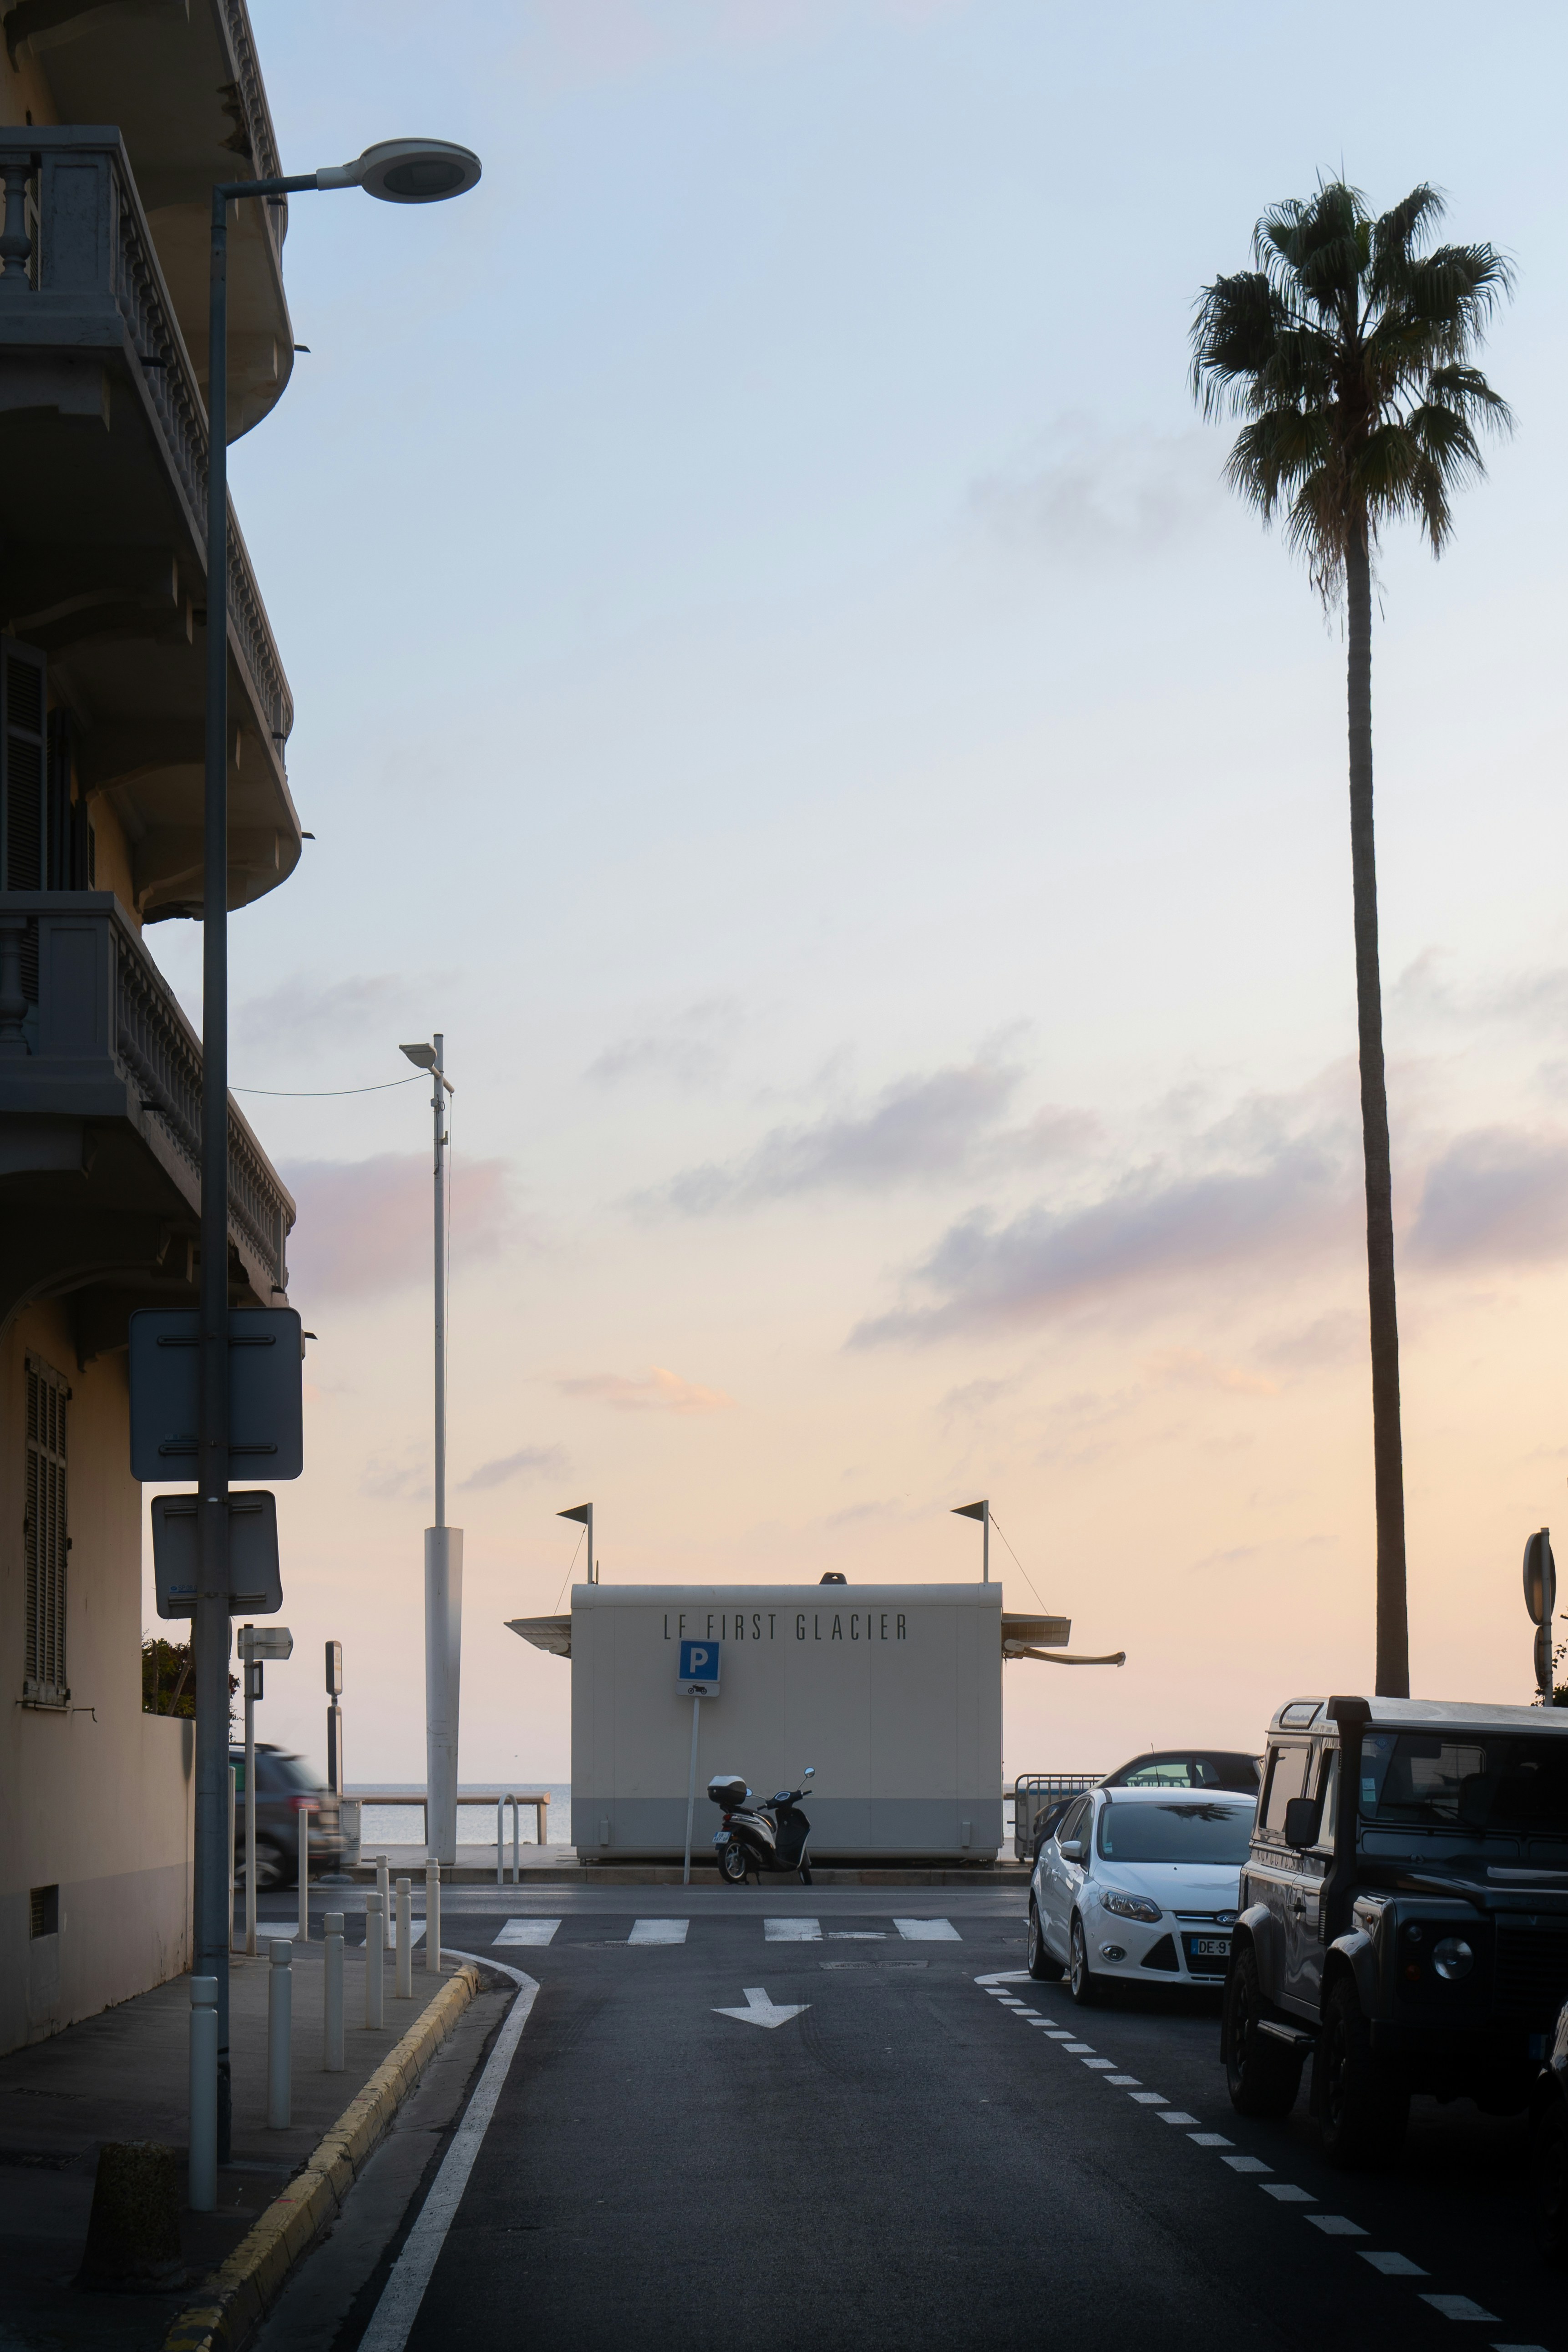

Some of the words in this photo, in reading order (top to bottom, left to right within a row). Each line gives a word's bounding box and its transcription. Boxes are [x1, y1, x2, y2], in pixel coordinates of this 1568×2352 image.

[707, 1614, 776, 1640] FIRST
[797, 1614, 906, 1640] GLACIER
[690, 1647, 708, 1673] P
